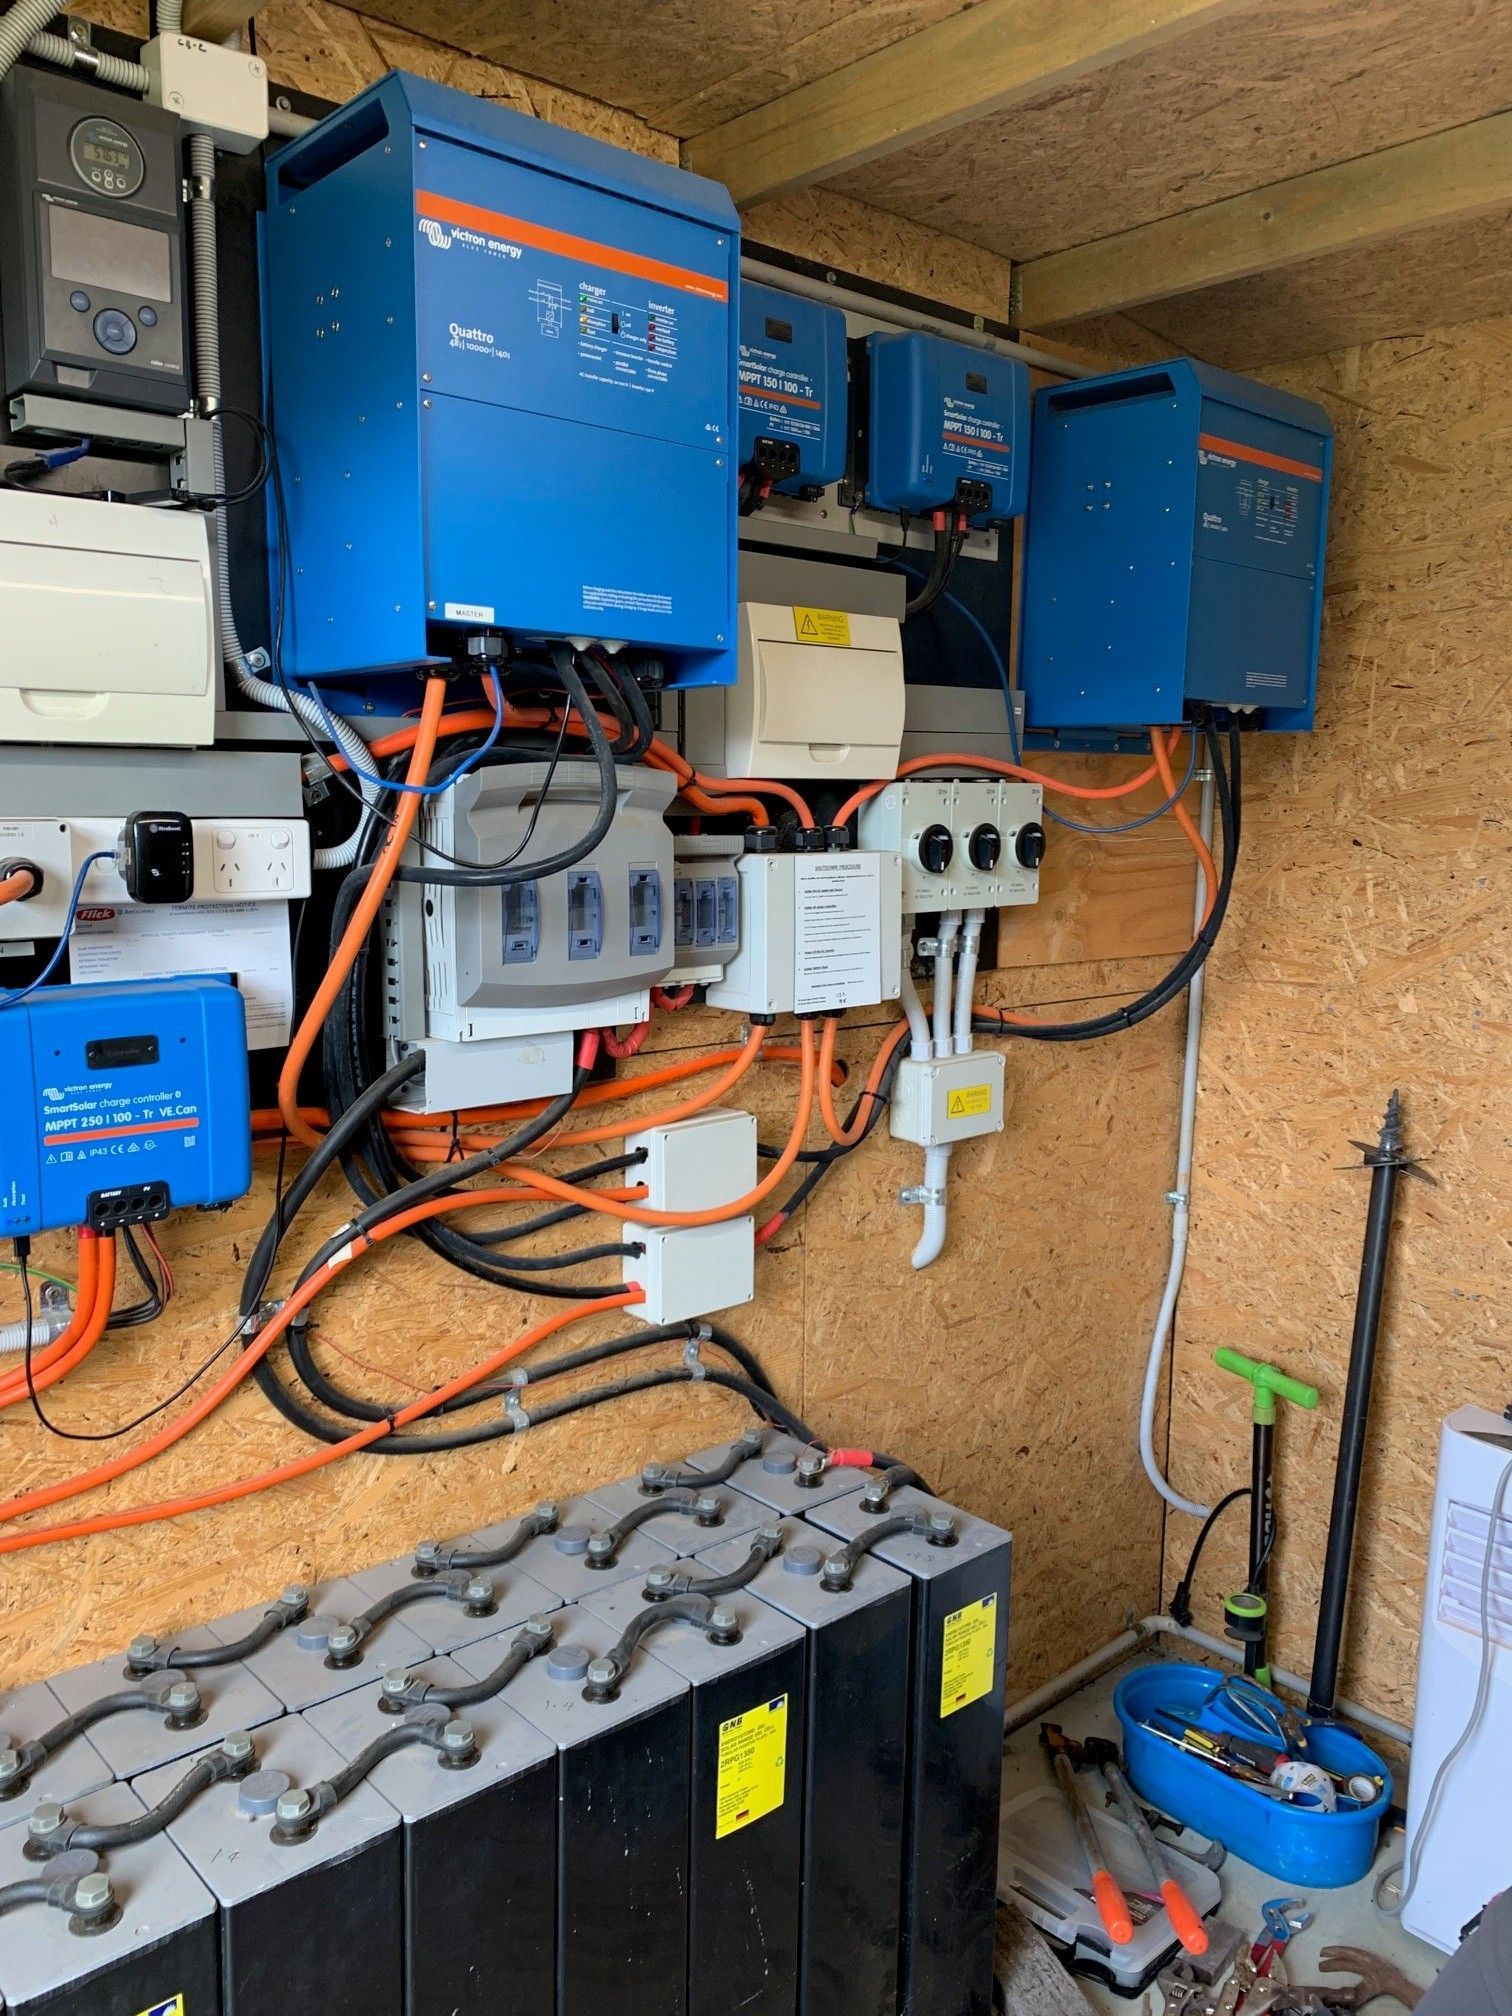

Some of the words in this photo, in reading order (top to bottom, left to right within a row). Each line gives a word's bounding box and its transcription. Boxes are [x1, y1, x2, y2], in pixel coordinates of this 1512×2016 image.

[451, 227, 486, 247] victron
[487, 239, 523, 259] energy
[578, 281, 606, 296] charger
[648, 300, 675, 315] inverter
[449, 322, 494, 344] Quattro
[767, 365, 786, 378] charge
[786, 371, 809, 383] controller
[739, 370, 761, 385] MPPT
[763, 375, 778, 390] 150
[783, 381, 798, 395] 100
[804, 385, 814, 398] Tr
[944, 419, 963, 433] MPPT
[963, 423, 976, 436] 150
[980, 428, 992, 440] 100
[996, 432, 1004, 443] Tr
[455, 609, 484, 618] MASTER
[839, 863, 862, 871] PROCEDURE
[64, 1085, 89, 1093] victron
[89, 1082, 112, 1092] energy
[44, 1100, 98, 1115] SmartSolar
[99, 1095, 131, 1109] charge
[132, 1090, 173, 1104] controller
[45, 1118, 78, 1132] MPPT
[81, 1115, 104, 1128] 250
[112, 1111, 132, 1124] 100
[142, 1108, 154, 1120] Tr
[159, 1104, 197, 1117] VE.Can
[90, 1147, 108, 1158] IP43
[100, 1189, 122, 1199] BATTERY
[722, 1716, 744, 1732] GNB
[720, 1746, 756, 1769] 2RPG1350
